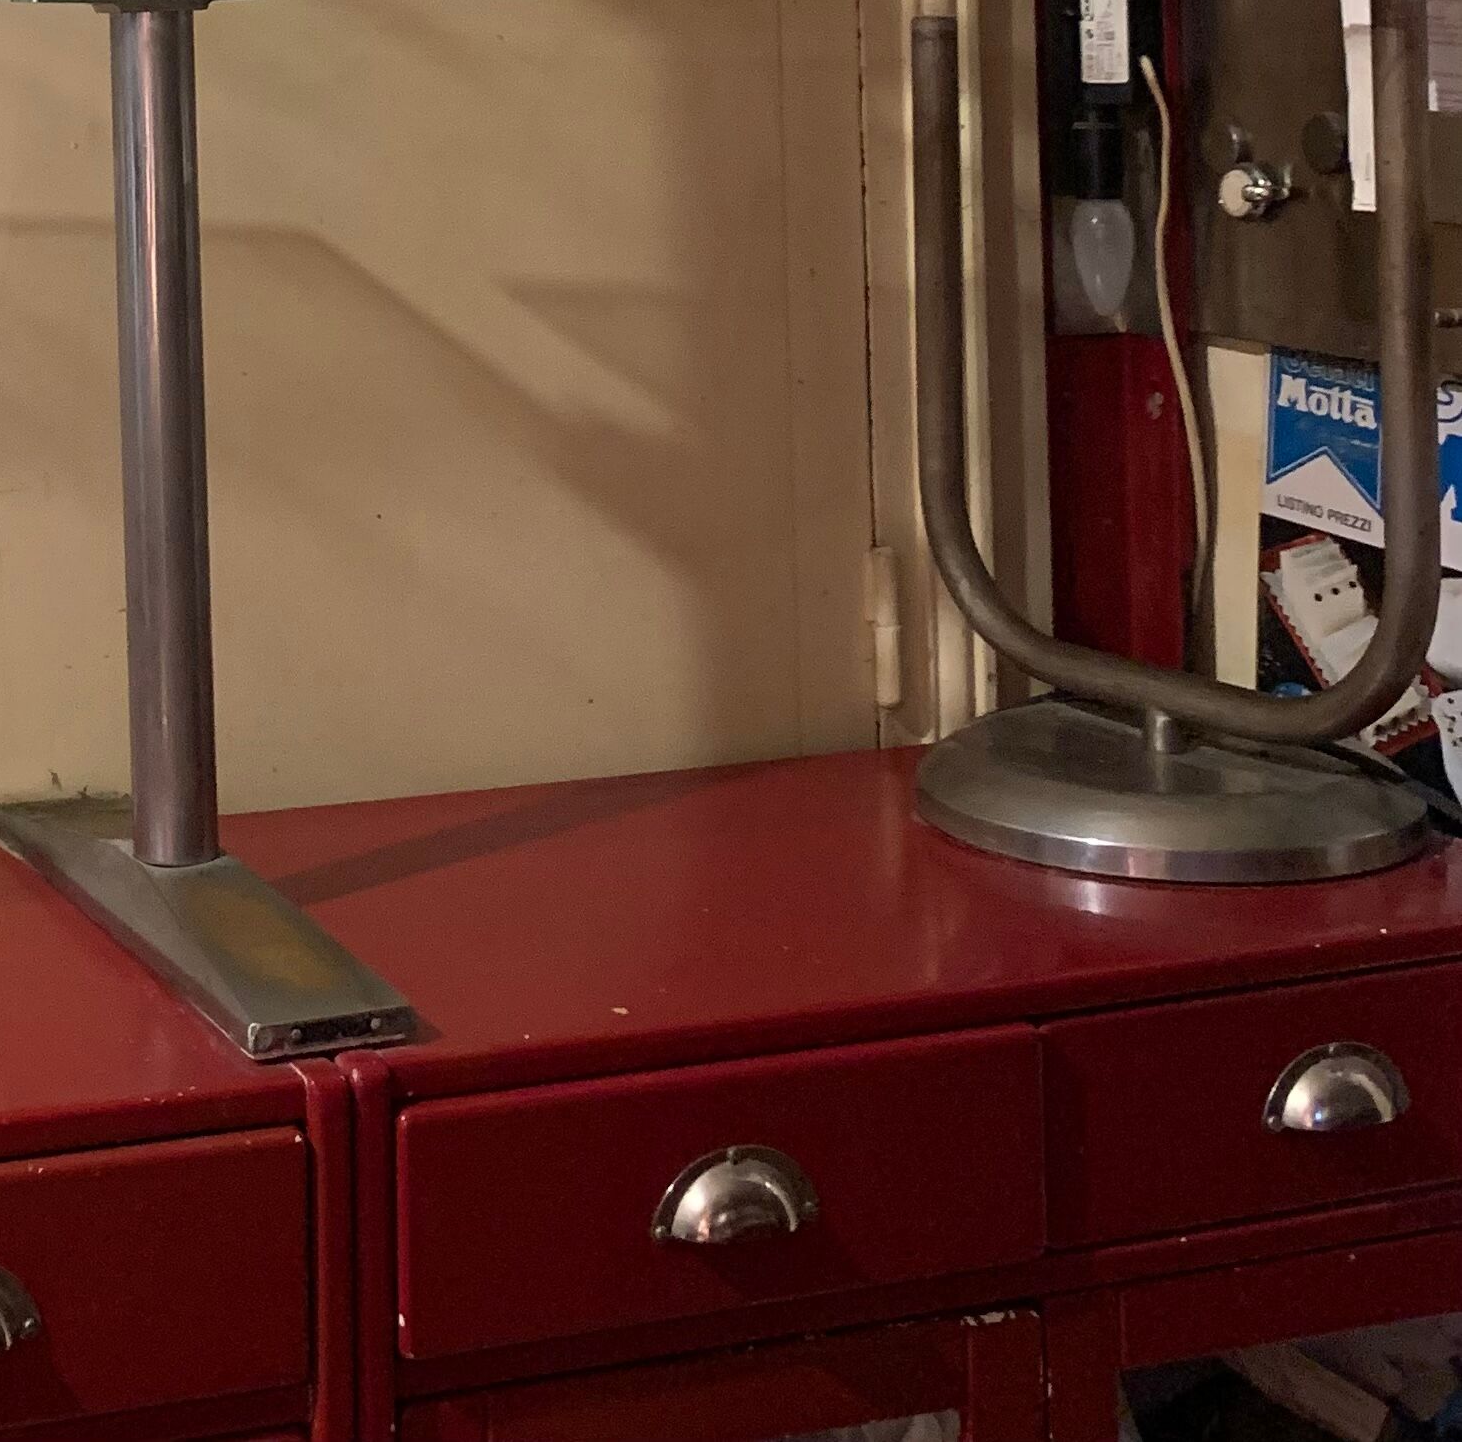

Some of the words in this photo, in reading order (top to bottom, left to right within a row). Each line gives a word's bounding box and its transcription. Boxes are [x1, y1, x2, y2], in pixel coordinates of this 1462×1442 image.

[1276, 373, 1378, 430] Motta
[1277, 494, 1323, 518] LISTINO
[1327, 508, 1371, 532] PREZZI
